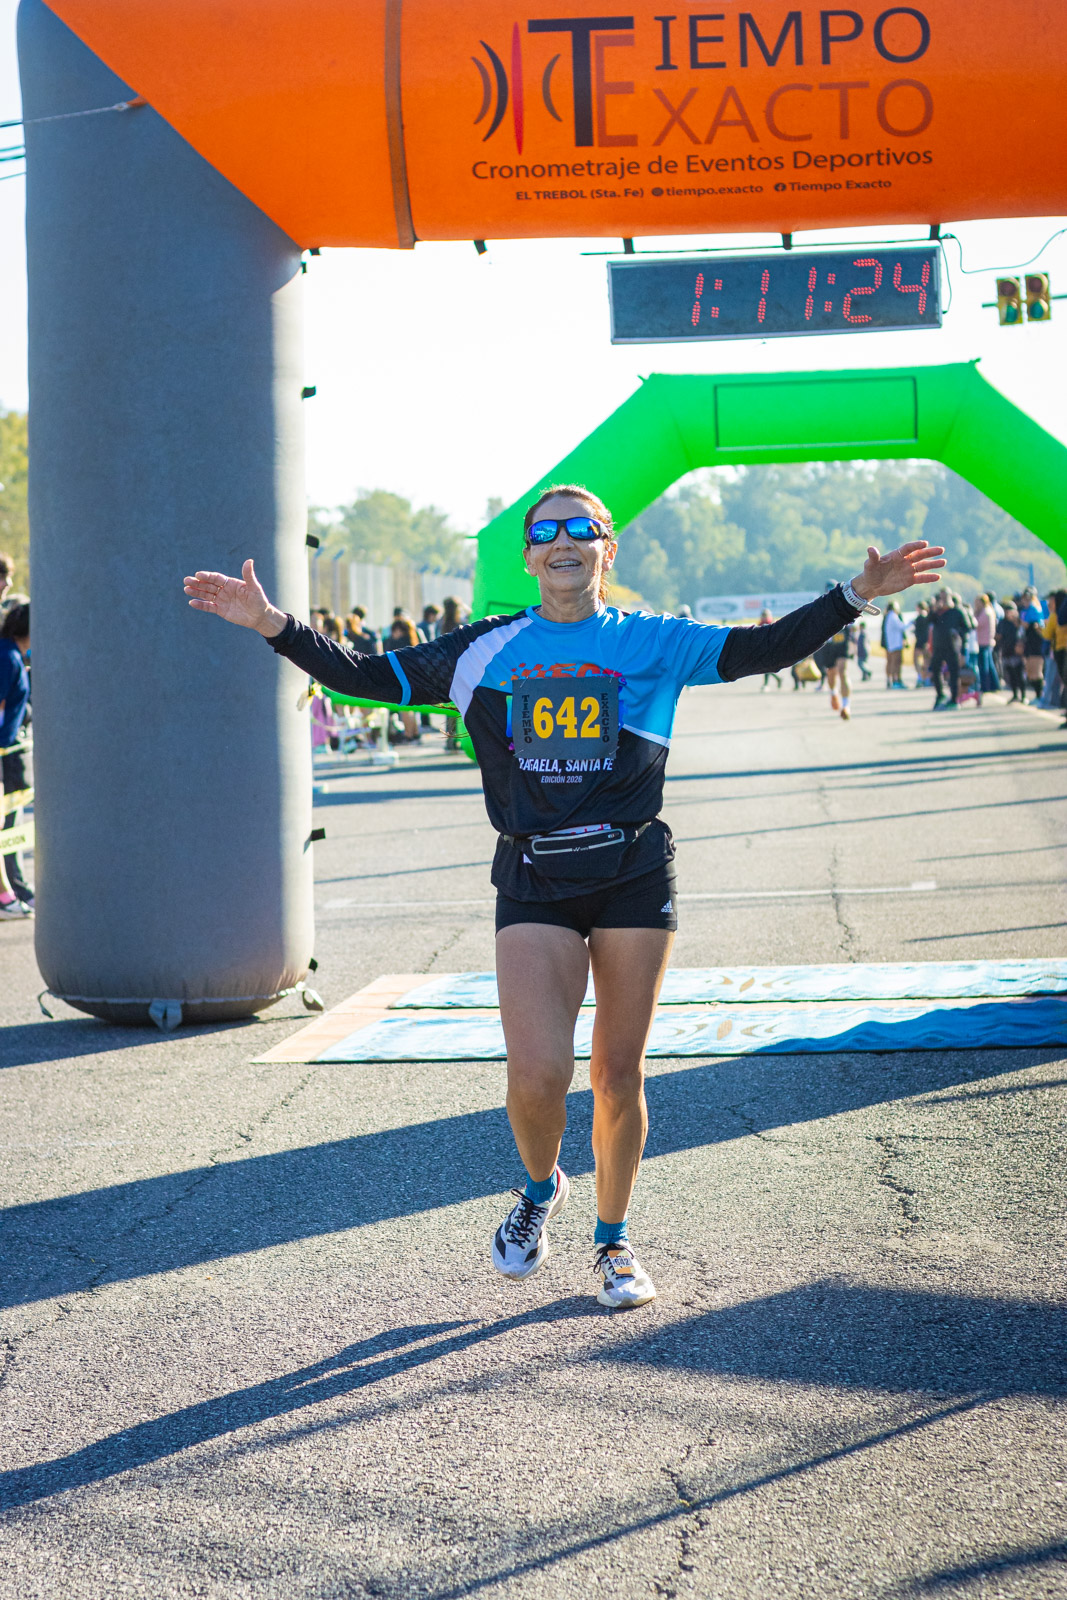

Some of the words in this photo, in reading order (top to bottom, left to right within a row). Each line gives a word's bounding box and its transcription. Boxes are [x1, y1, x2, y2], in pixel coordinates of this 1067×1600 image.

[472, 158, 640, 180] Cronometraje
[647, 155, 679, 175] de
[686, 154, 785, 173] Eventos
[793, 148, 933, 172] Deportivos
[516, 191, 531, 200] EL
[534, 189, 586, 200] TREBOL
[590, 188, 621, 200] (Sta.
[624, 187, 644, 198] Fe)
[666, 185, 764, 197] tiempo.exacto
[789, 181, 842, 192] Tiempo
[846, 179, 892, 190] Exacto
[522, 694, 532, 744] TIEMPO
[533, 697, 600, 738] 642
[601, 693, 609, 743] EXACTO
[565, 758, 600, 772] SANTA
[603, 758, 613, 771] FE
